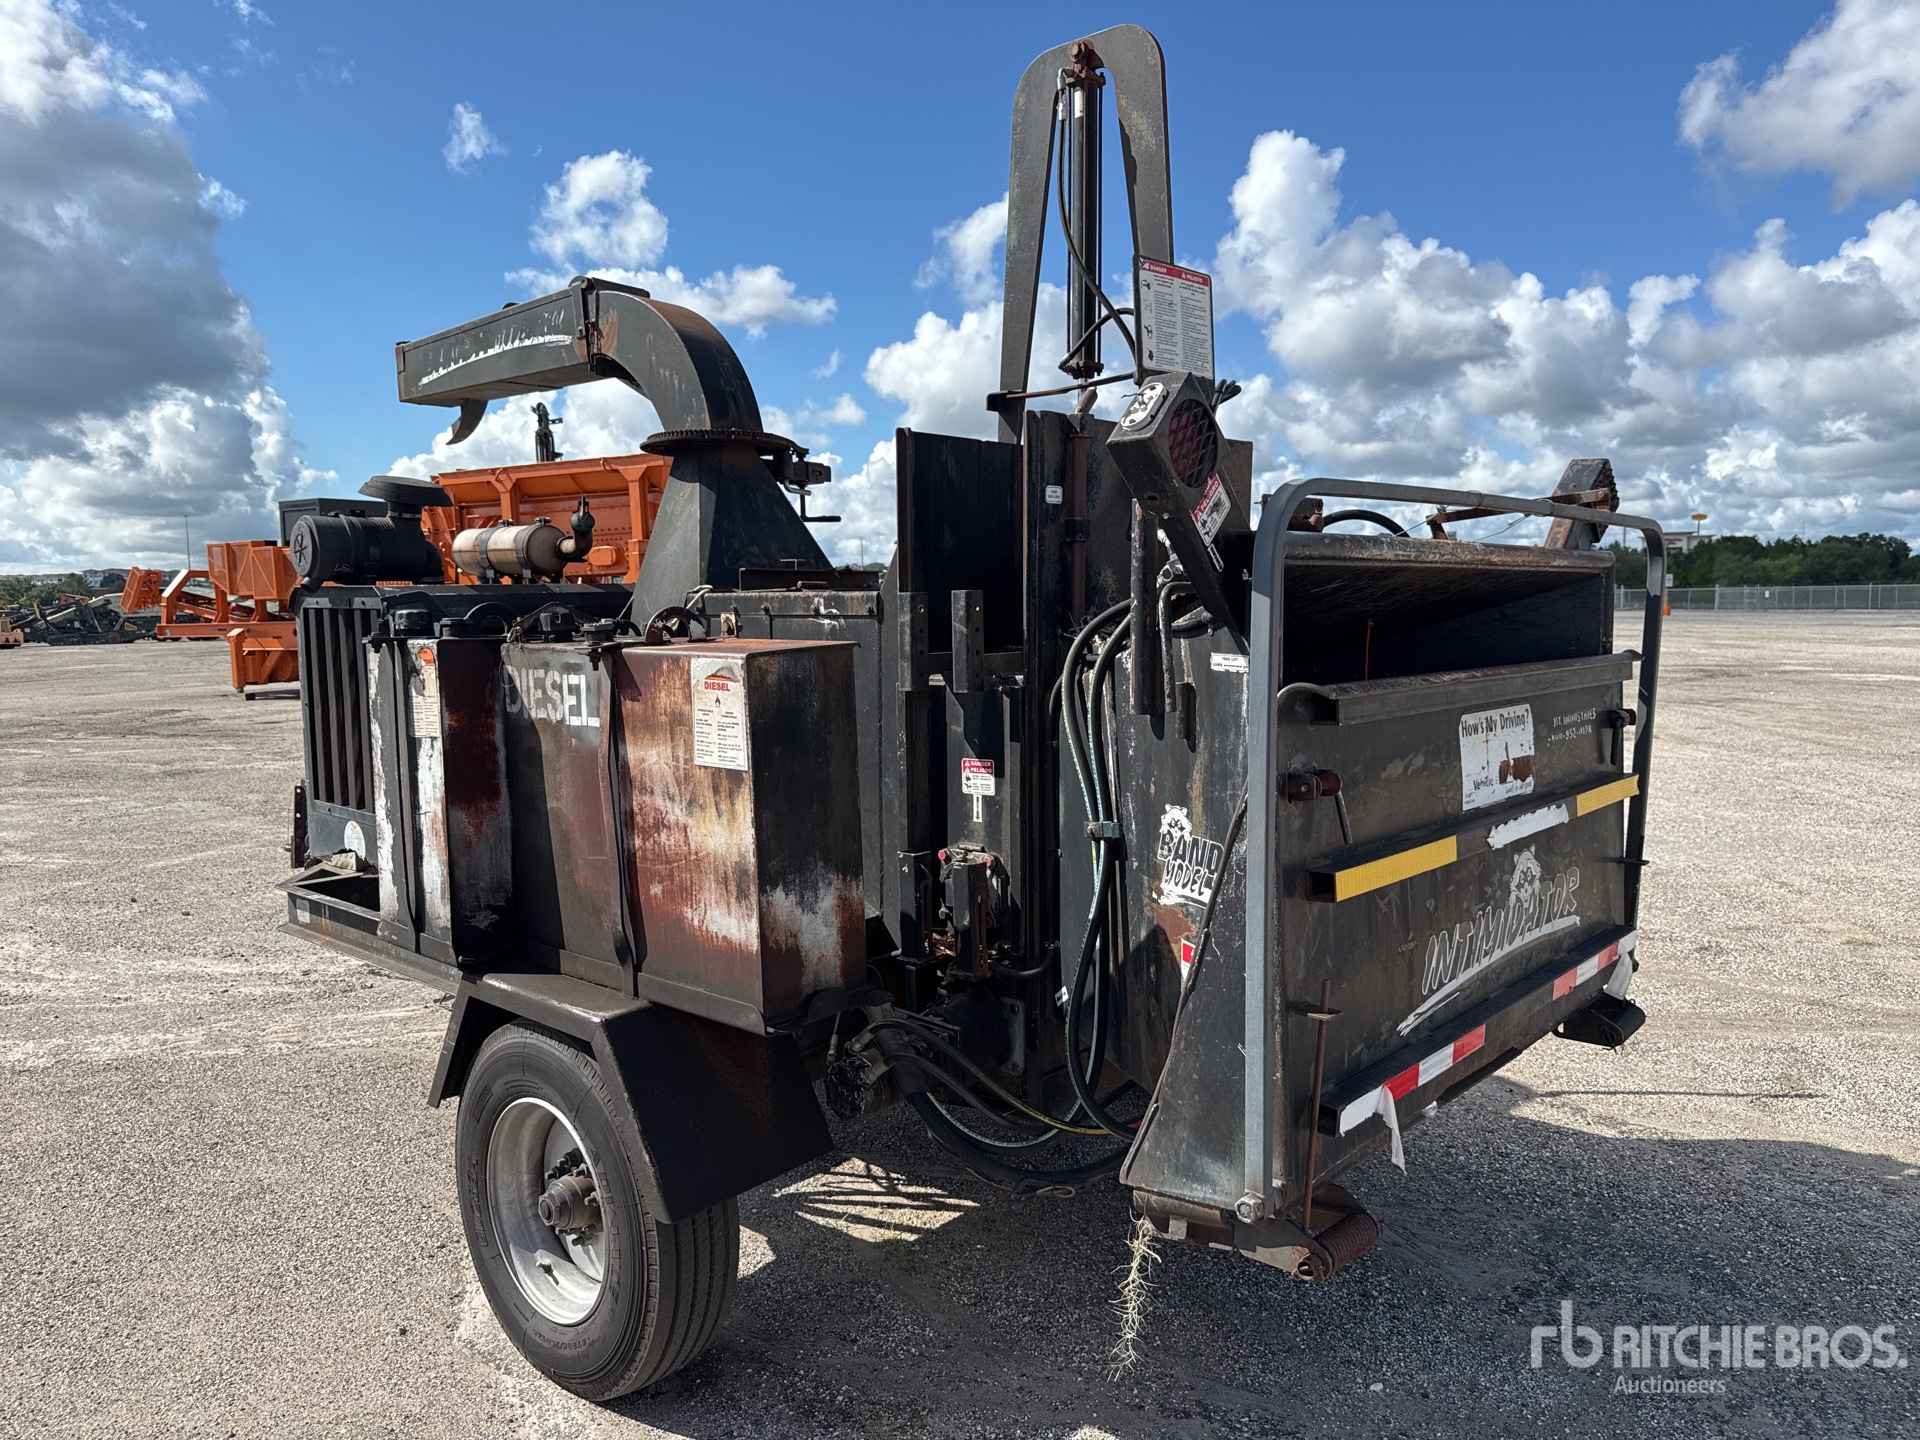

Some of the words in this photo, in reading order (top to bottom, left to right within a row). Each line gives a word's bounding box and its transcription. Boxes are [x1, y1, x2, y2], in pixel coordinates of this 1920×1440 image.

[1200, 481, 1219, 511] PELIGRO
[503, 664, 600, 728] DIESEL
[704, 681, 731, 692] DIESEL
[1461, 718, 1484, 738] How's
[1499, 708, 1529, 731] Driving?
[1422, 867, 1580, 995] INTIMIDATOR
